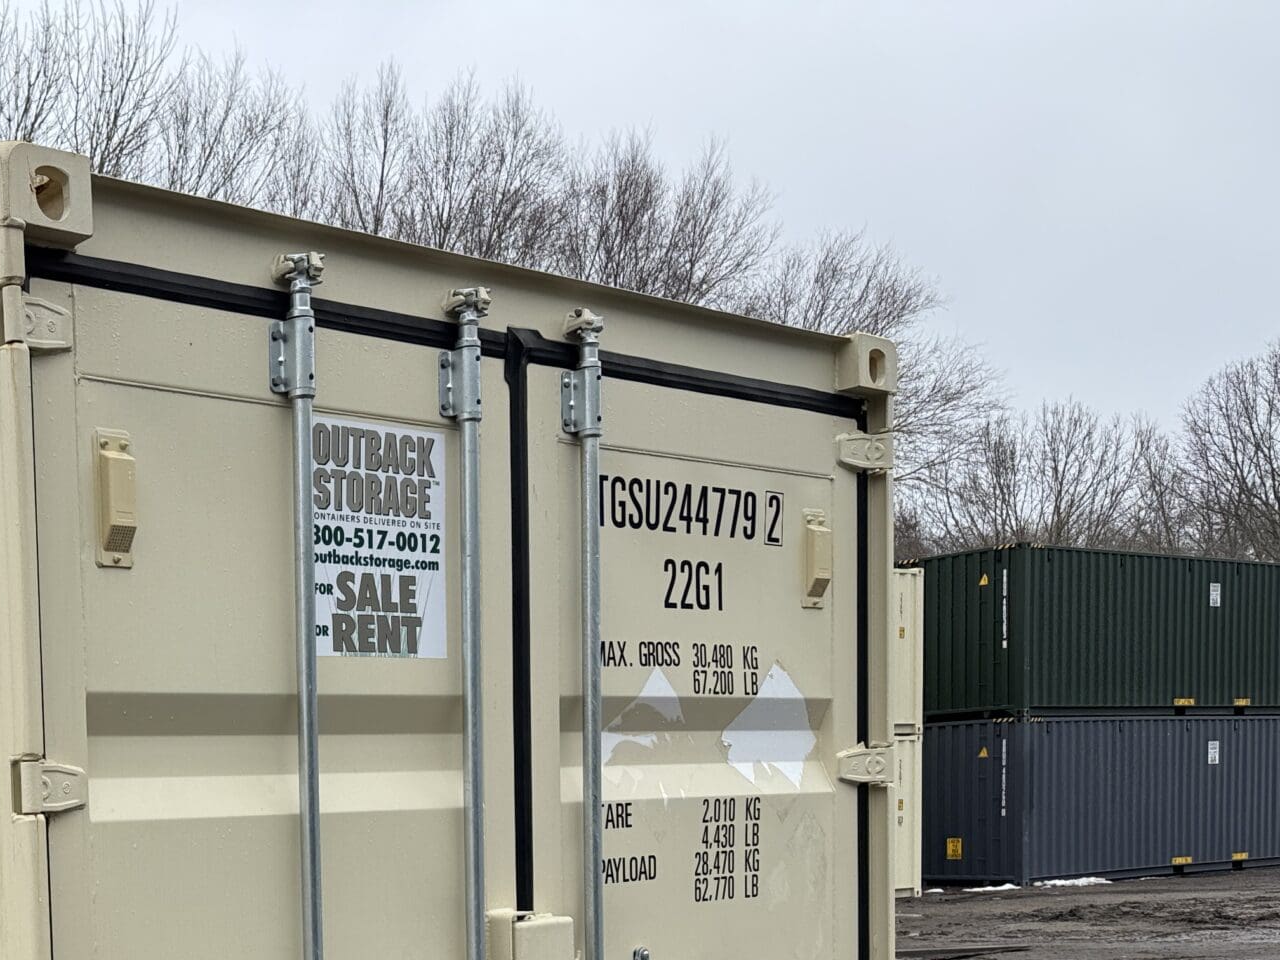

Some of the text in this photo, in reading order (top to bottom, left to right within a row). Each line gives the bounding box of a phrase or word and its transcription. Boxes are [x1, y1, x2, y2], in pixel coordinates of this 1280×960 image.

[312, 423, 435, 478] OUTBACK
[313, 468, 432, 519] STORAGE
[314, 511, 440, 531] ONTAINERS DELIVERED ON SITE
[767, 494, 780, 544] 2
[336, 571, 417, 613] SALE
[663, 559, 724, 611] 22G1
[332, 613, 422, 653] RENT
[639, 642, 680, 667] GROSS
[692, 643, 733, 670] 30,480
[743, 646, 758, 670] KG
[693, 670, 758, 696] 67,200 LB
[601, 797, 761, 830] ARE 2,010 KG
[702, 823, 760, 849] 4,430 LB
[694, 850, 735, 877] 28,470
[744, 849, 760, 873] KG
[694, 874, 759, 902] 62,770 LB
